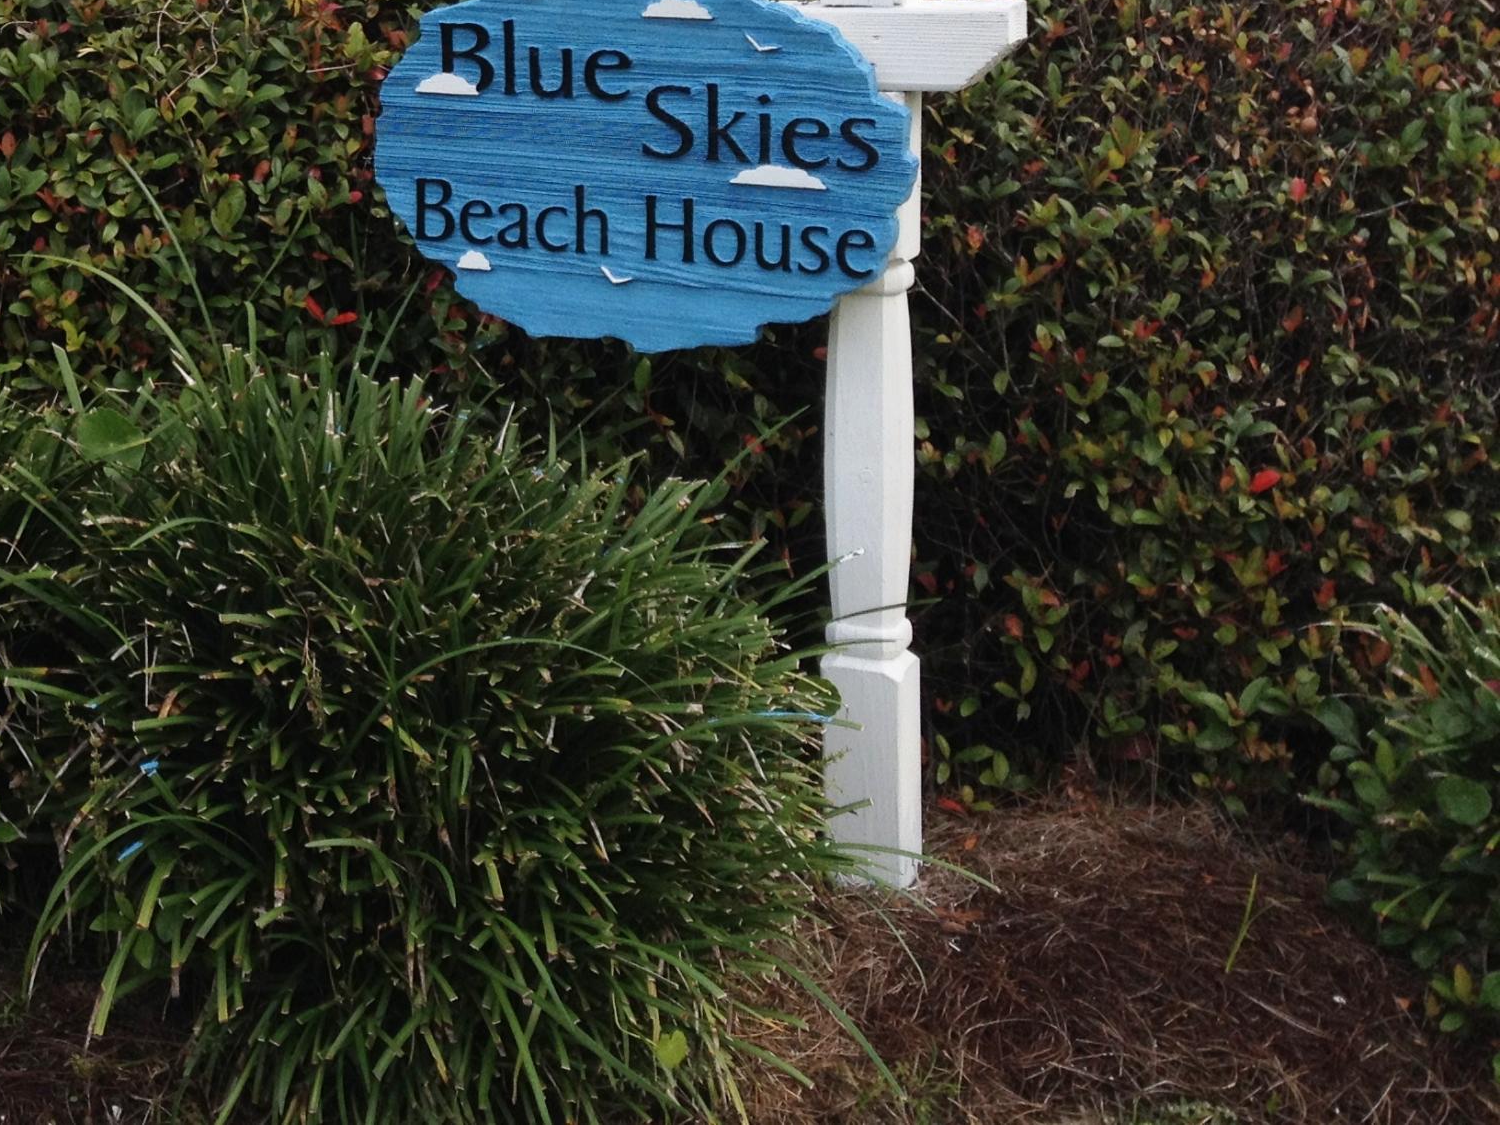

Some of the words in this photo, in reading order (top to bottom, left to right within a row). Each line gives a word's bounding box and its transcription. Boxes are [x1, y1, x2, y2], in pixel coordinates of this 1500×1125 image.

[438, 19, 634, 102] Blue
[641, 82, 881, 173] Skies
[414, 177, 610, 256] Beach
[644, 194, 876, 277] House
